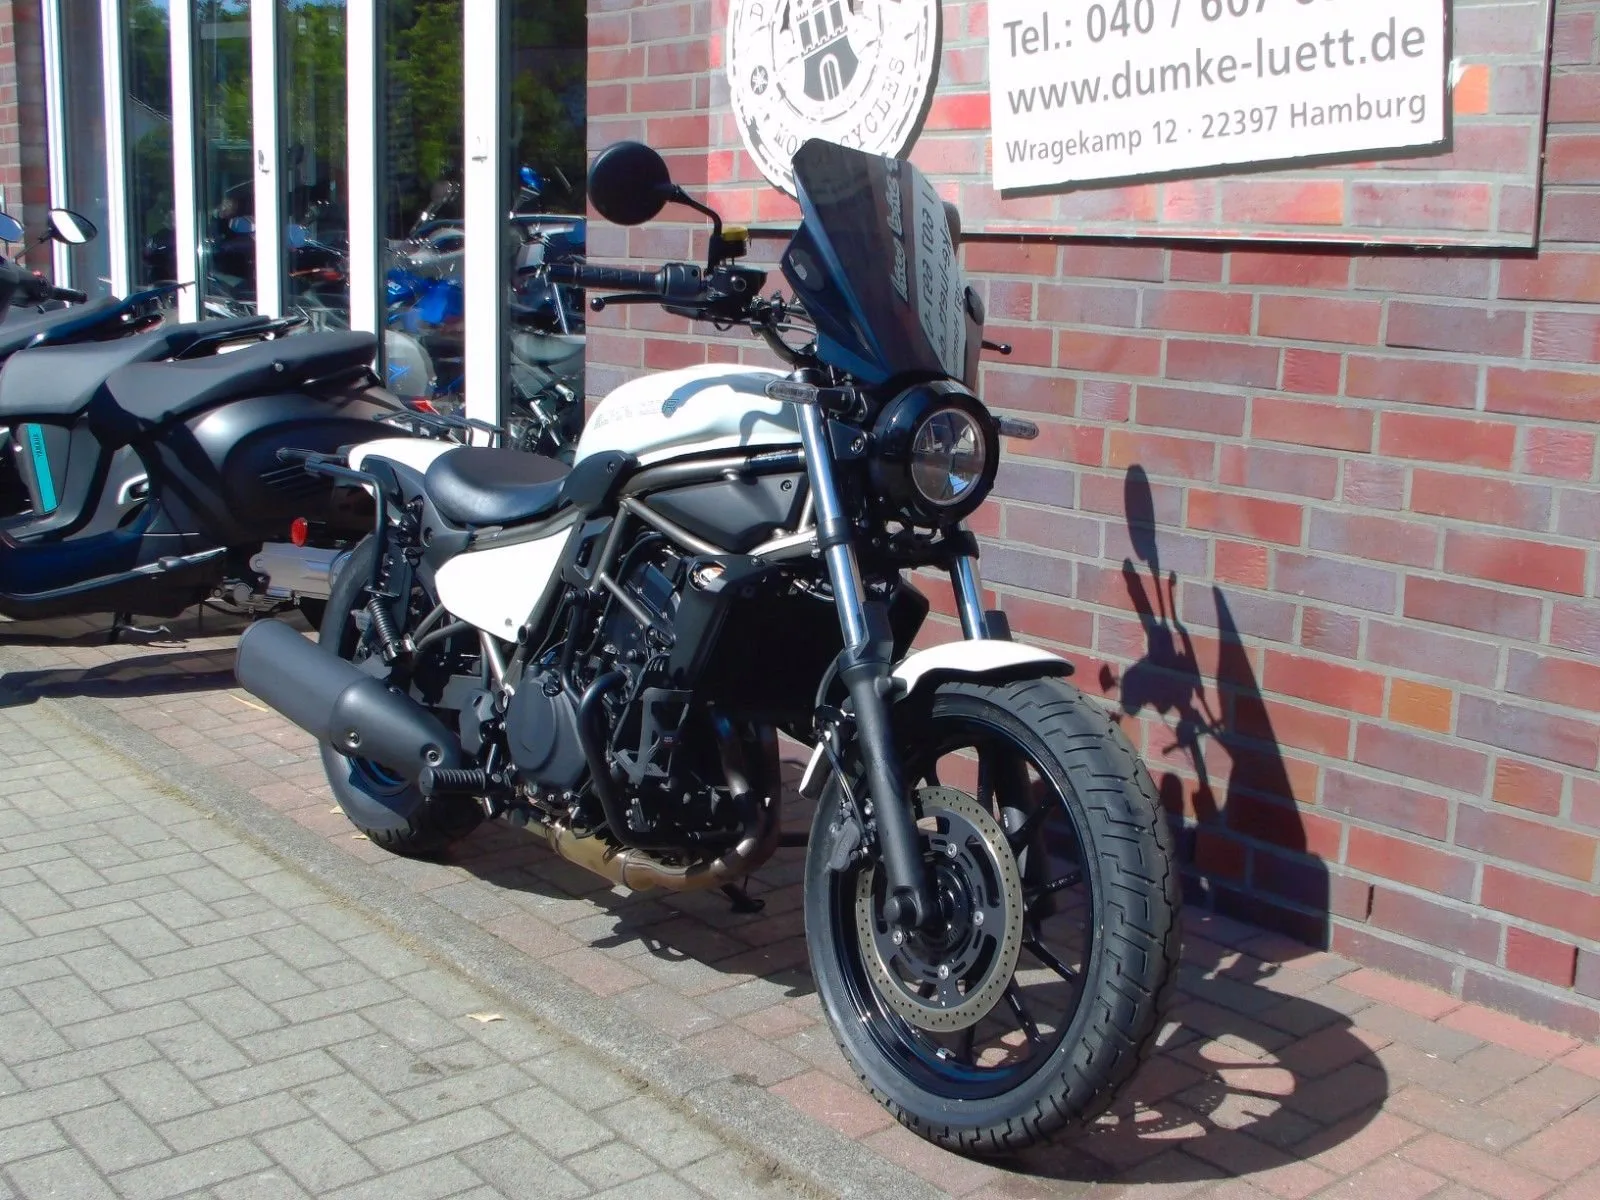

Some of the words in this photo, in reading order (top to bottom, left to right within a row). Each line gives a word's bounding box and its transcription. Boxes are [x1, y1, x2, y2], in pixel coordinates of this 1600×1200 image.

[1003, 11, 1072, 57] Tel.:
[1086, 0, 1155, 43] 040
[1007, 16, 1425, 114] www.dumke-luett.de
[1006, 129, 1142, 165] Wragekamp
[1152, 119, 1178, 145] 12
[1201, 105, 1279, 139] 22397
[1290, 92, 1426, 129] Hamburg
